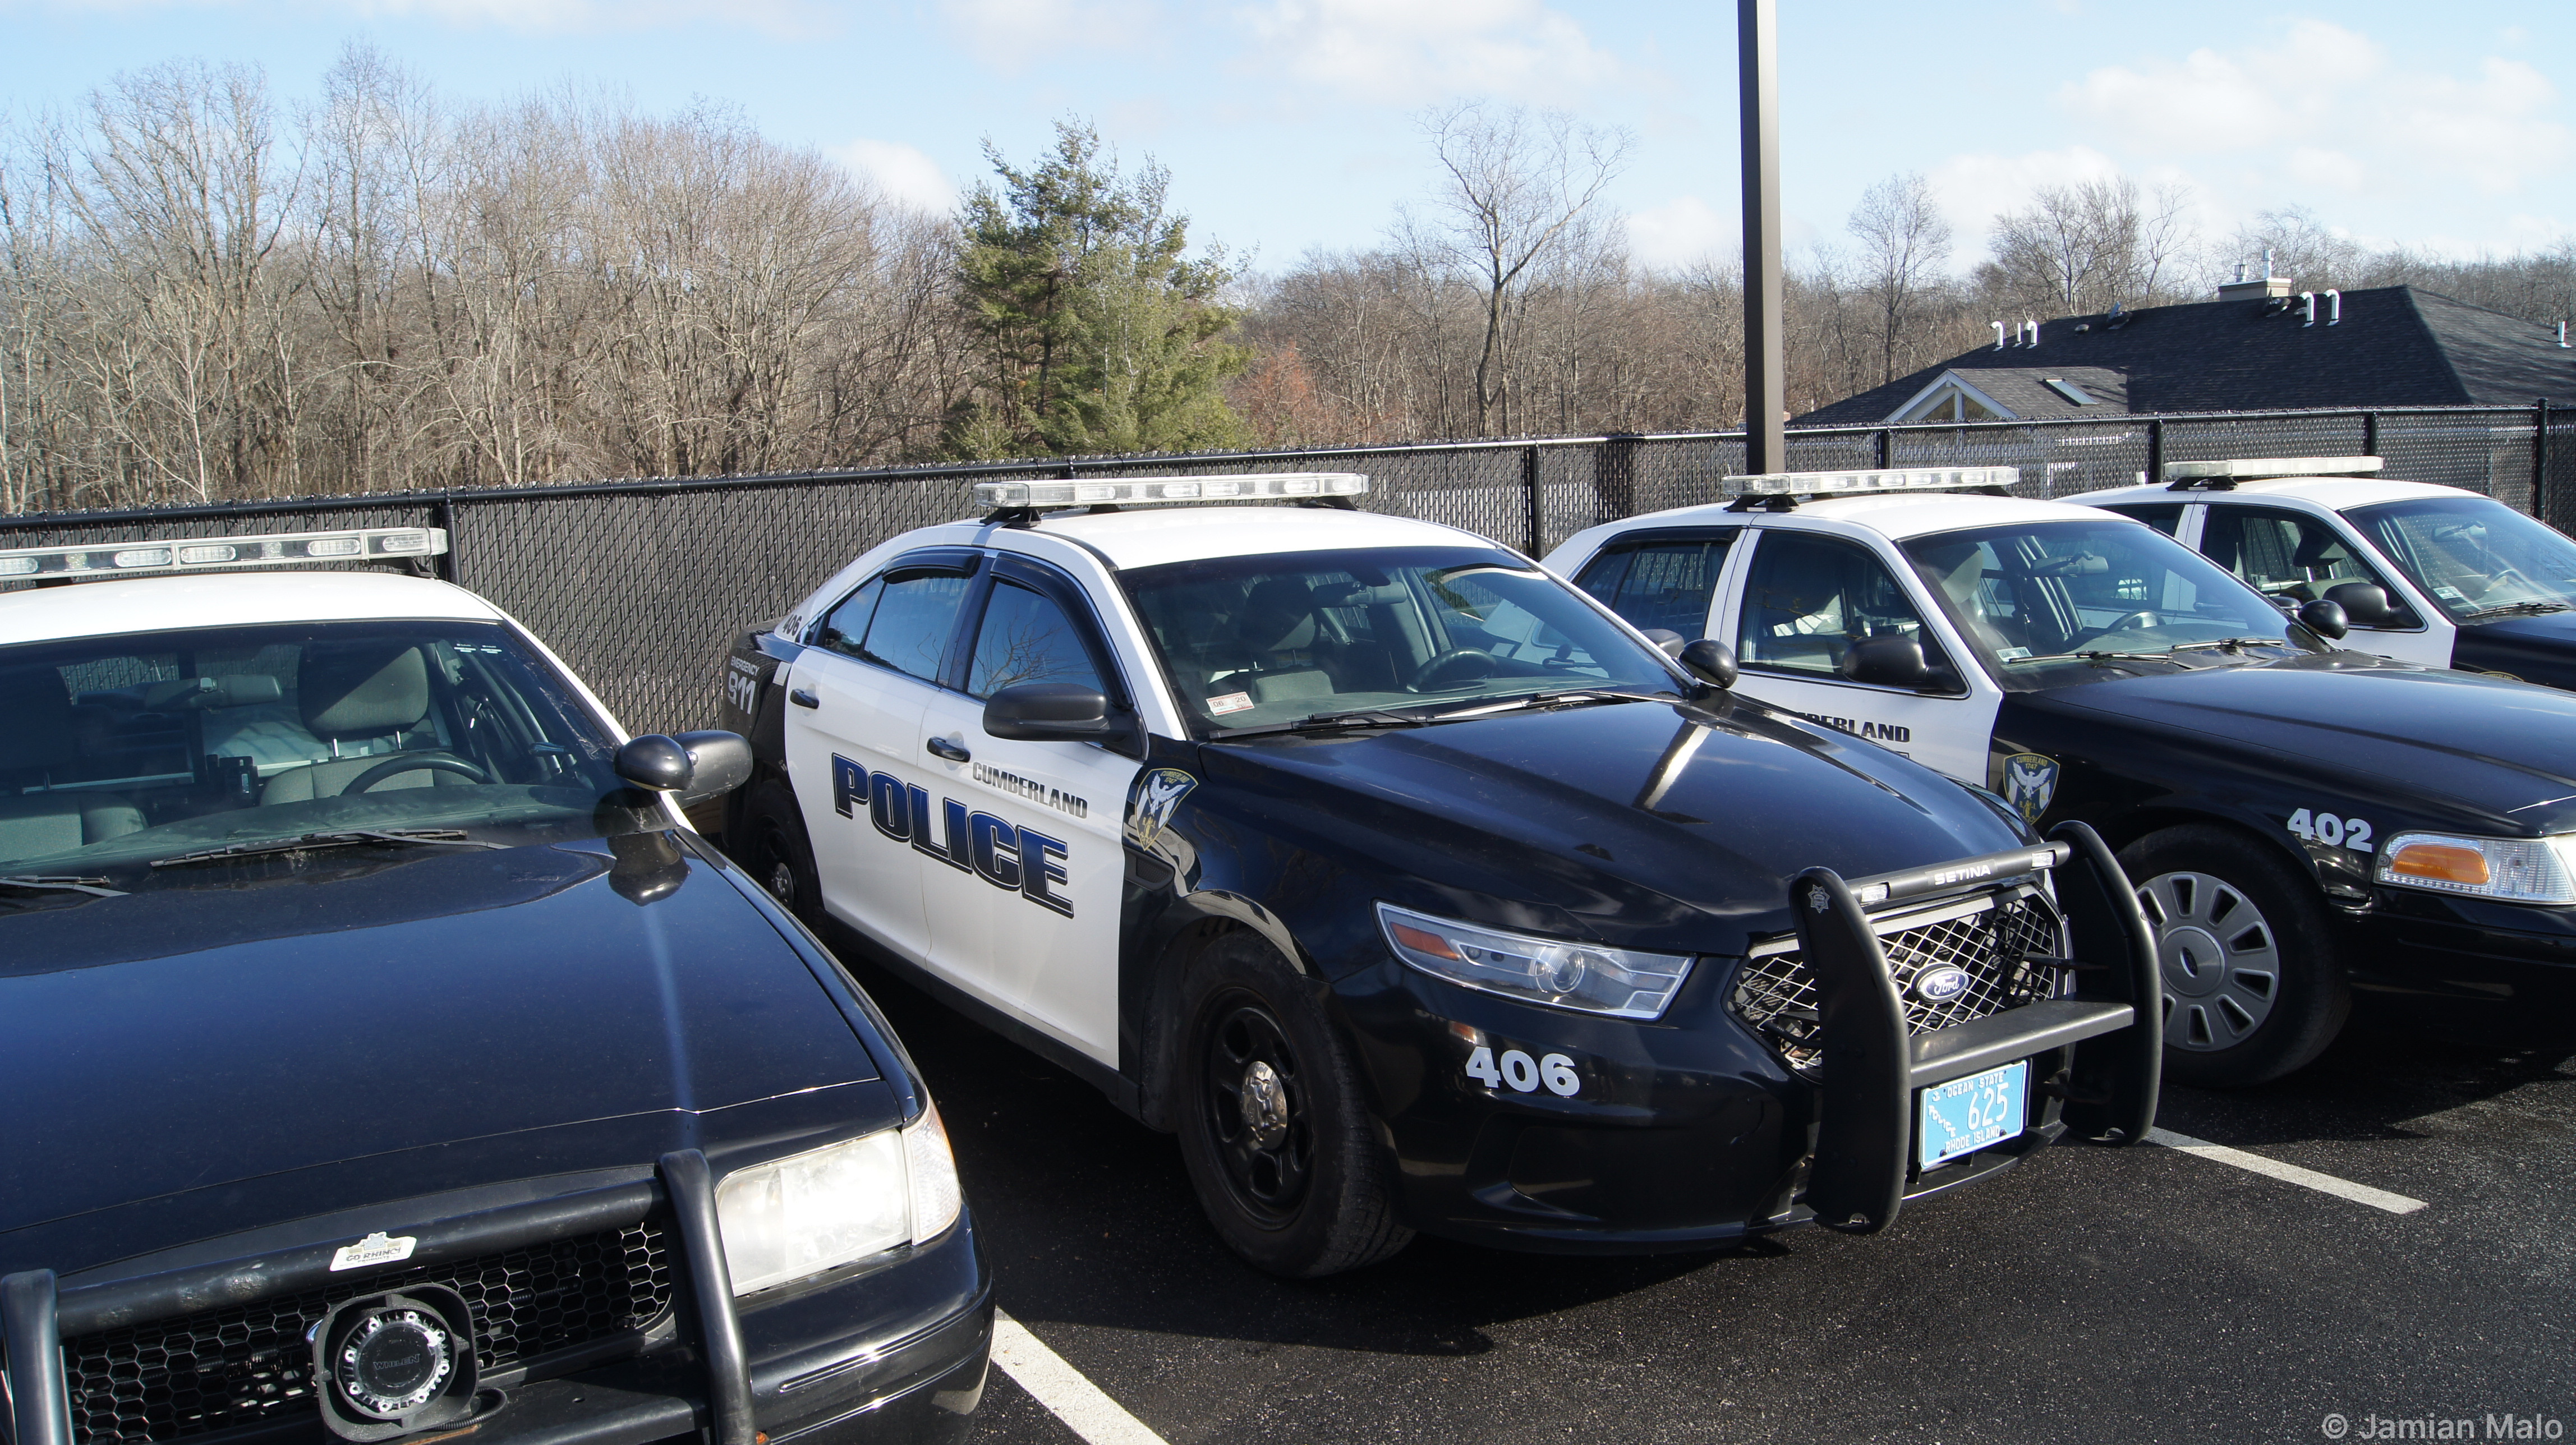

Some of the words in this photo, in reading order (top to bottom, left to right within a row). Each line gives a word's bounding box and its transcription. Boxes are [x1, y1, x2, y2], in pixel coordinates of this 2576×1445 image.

[783, 614, 802, 636] 406
[730, 656, 760, 676] EMERGENCY
[728, 671, 756, 715] 911
[2016, 756, 2048, 767] CUMBERLAND
[973, 762, 1088, 818] CUMBERLAND
[1160, 770, 1190, 783] CUMBERLAND
[831, 752, 1074, 918] POLICE
[2287, 808, 2373, 853] 402
[1934, 864, 1991, 886] SETINA
[1933, 974, 1959, 995] Ford
[1465, 1046, 1580, 1096] 406
[1947, 1080, 1974, 1098] OCEAN
[1979, 1072, 2004, 1088] STATE
[1967, 1082, 2009, 1130] 625
[1928, 1105, 1956, 1138] POLICE
[1945, 1135, 1970, 1153] RHODE
[1974, 1125, 2000, 1144] ISLAND
[373, 1354, 420, 1370] WHELEN
